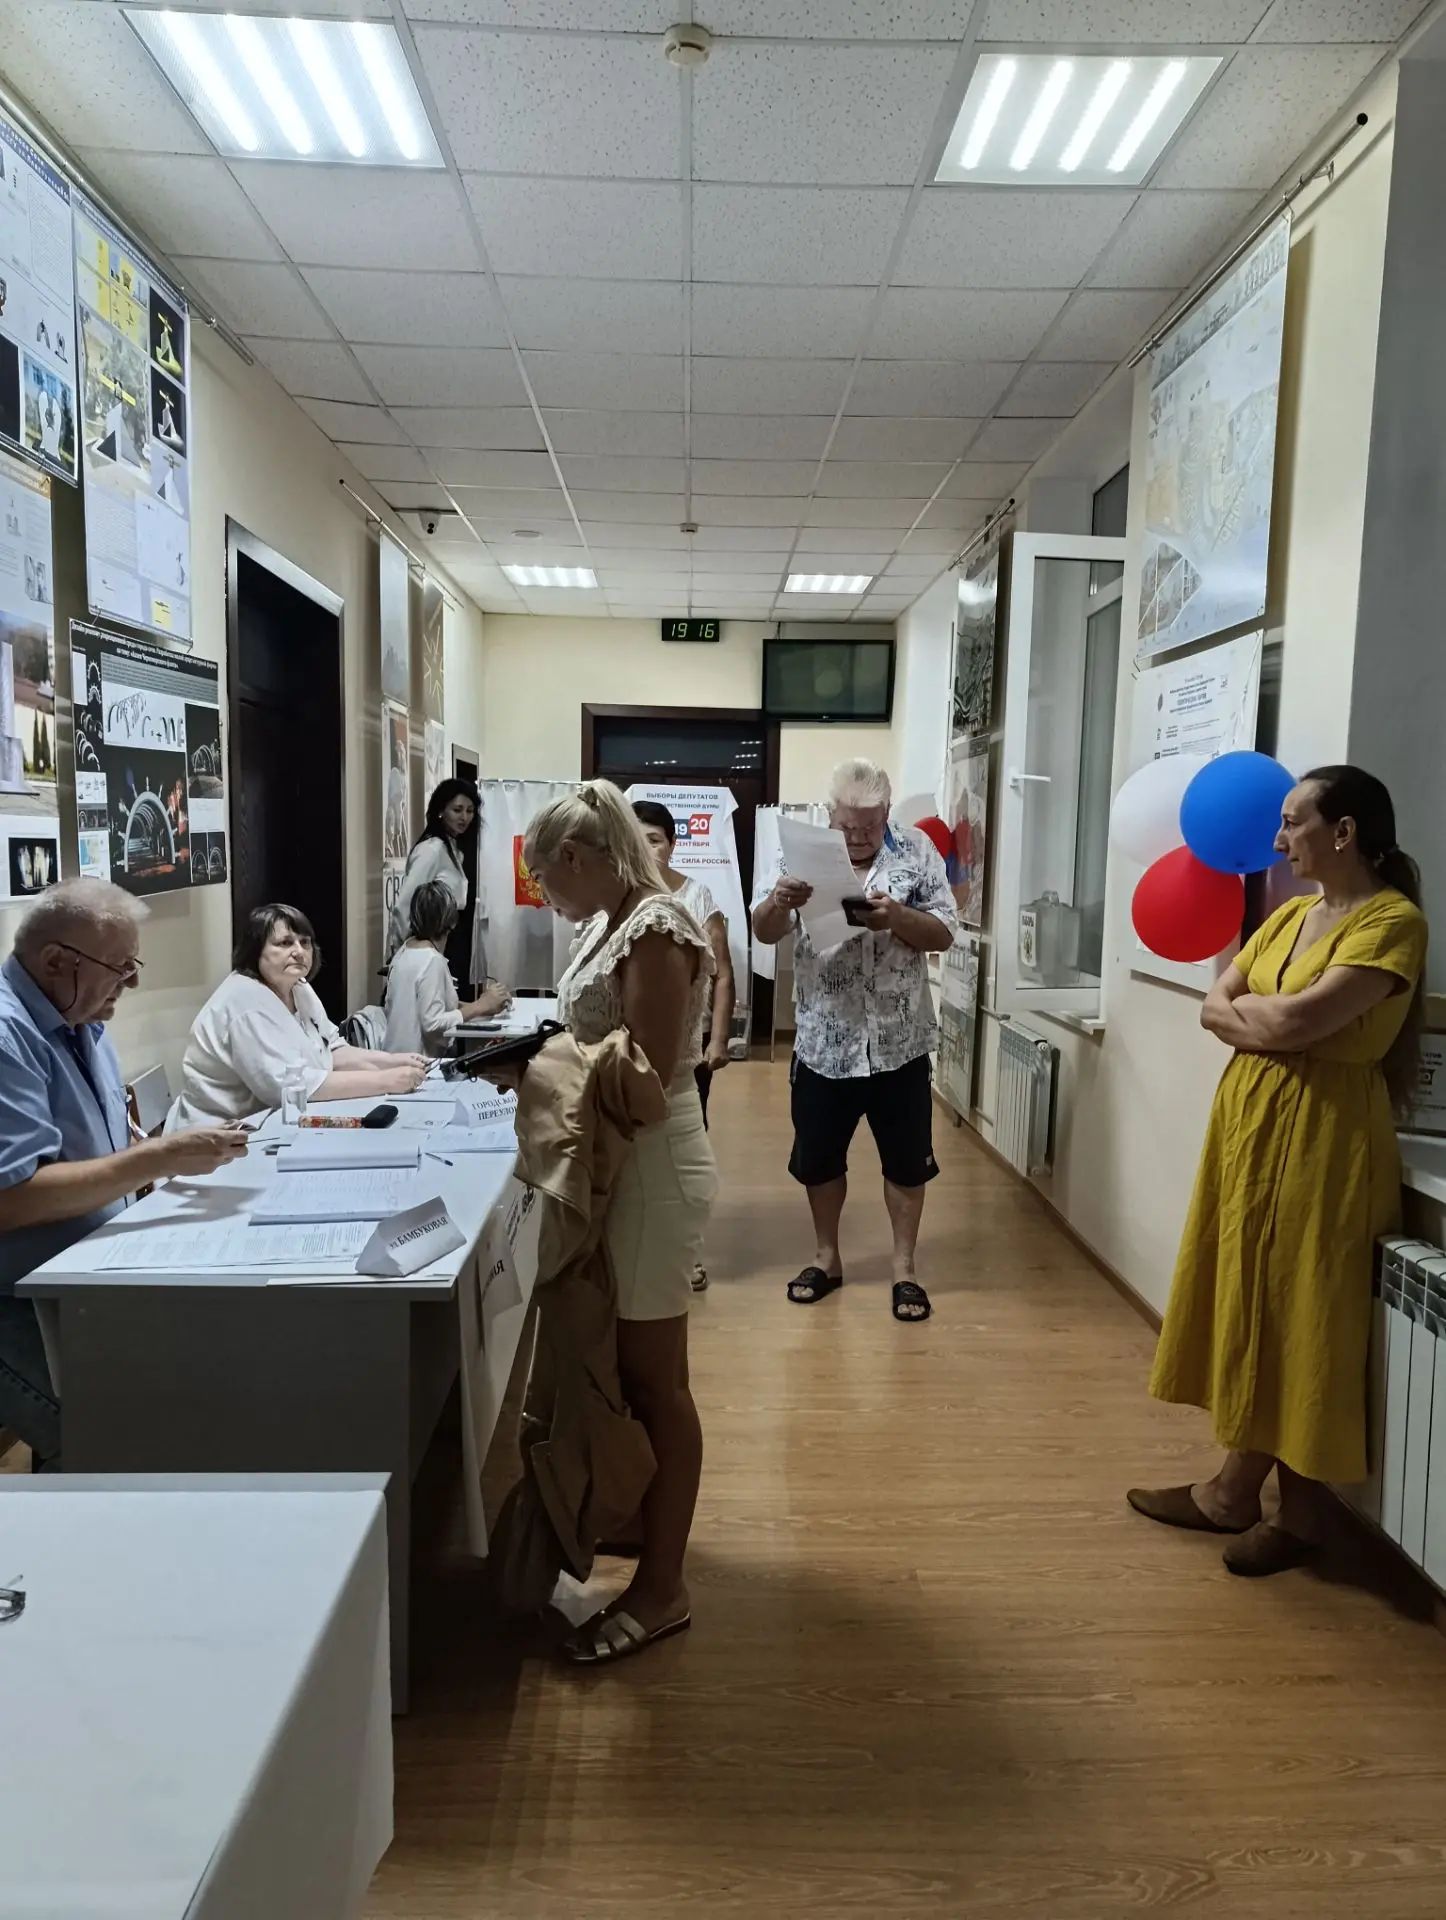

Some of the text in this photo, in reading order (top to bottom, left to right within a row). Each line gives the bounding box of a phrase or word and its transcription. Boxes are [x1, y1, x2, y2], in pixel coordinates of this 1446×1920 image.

[671, 623, 715, 638] 19 16
[675, 818, 708, 836] 19 20
[397, 1216, 448, 1246] БАМБУКОВАЯ
